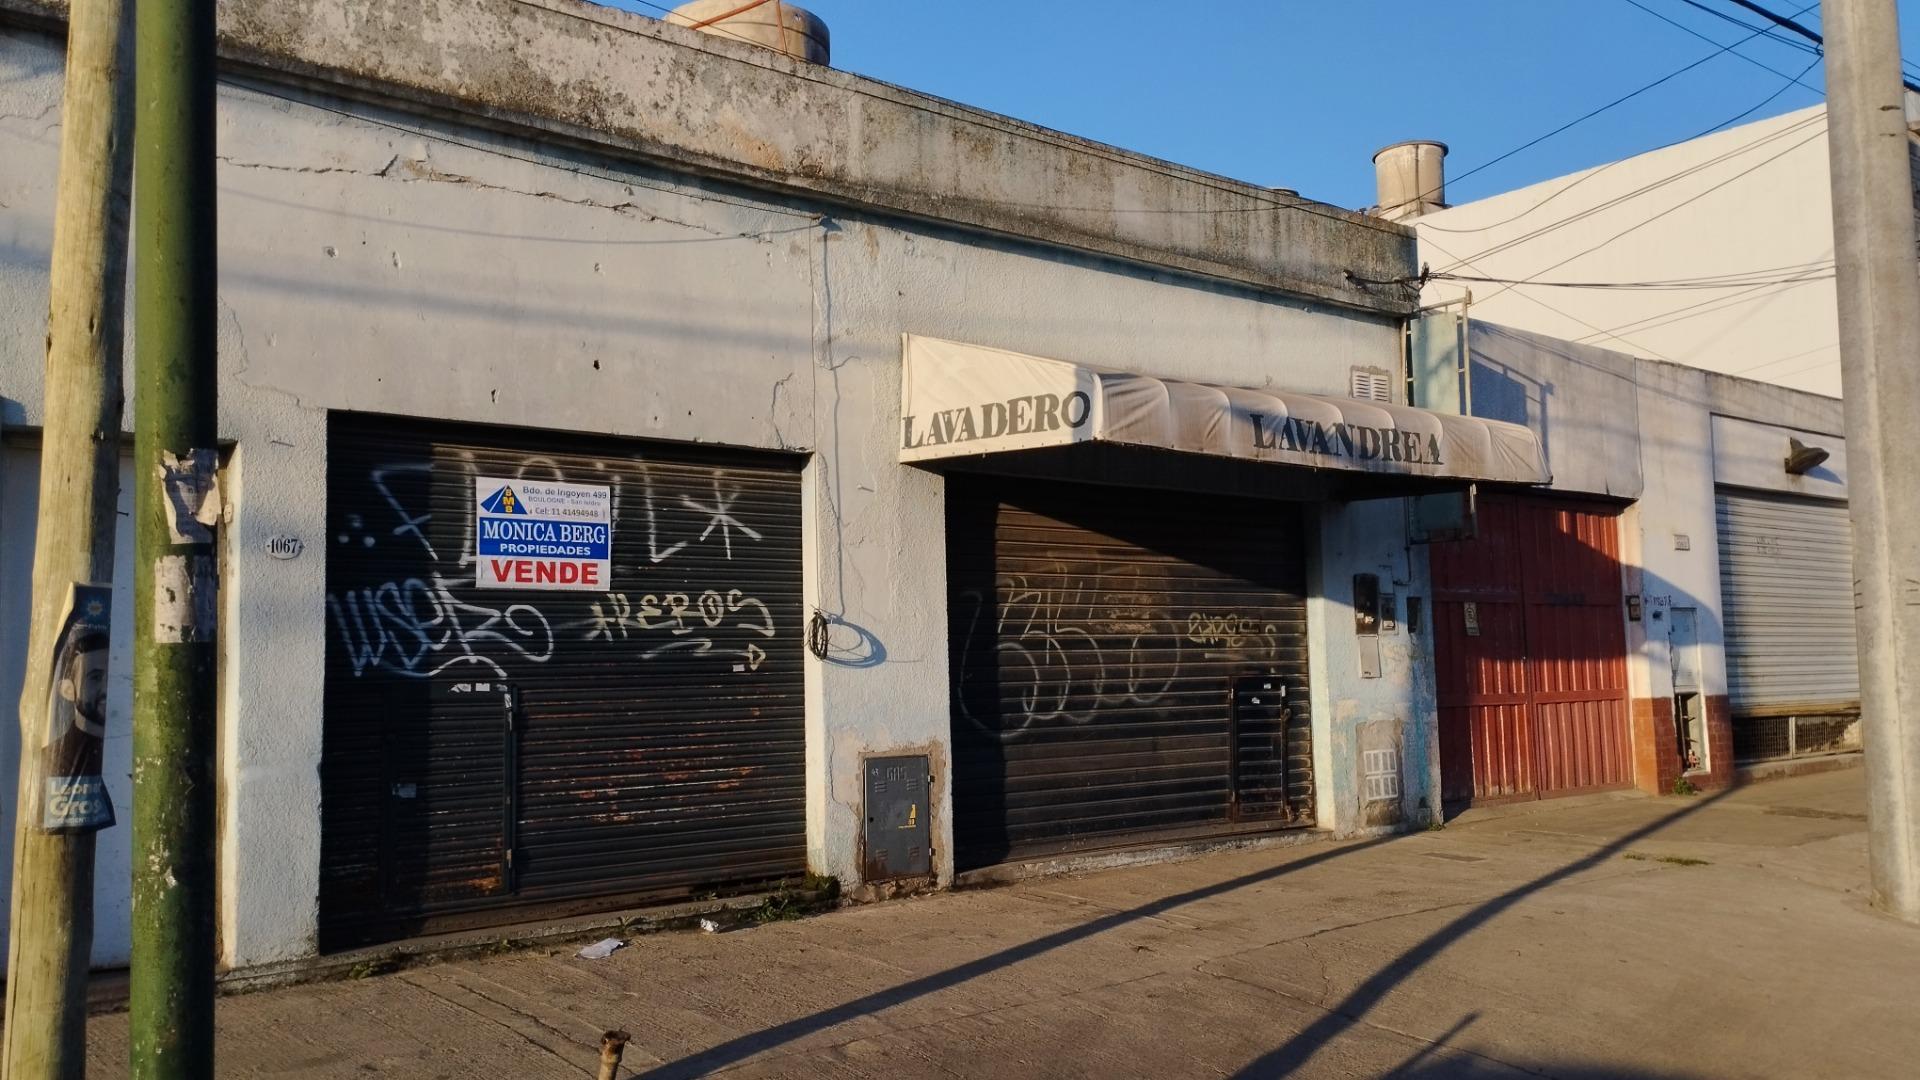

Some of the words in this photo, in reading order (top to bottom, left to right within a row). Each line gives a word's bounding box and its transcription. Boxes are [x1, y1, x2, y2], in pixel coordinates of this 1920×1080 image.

[902, 391, 1091, 450] LAVADERO
[1250, 413, 1444, 465] LAVANDREA
[523, 486, 542, 495] Bdo.
[558, 489, 590, 498] Irigoyen
[593, 491, 607, 499] 499
[483, 520, 557, 542] MONICA
[560, 524, 606, 544] BERG
[271, 538, 298, 554] 1067
[500, 543, 591, 556] PROPIEDADES
[491, 559, 599, 585] VENDE
